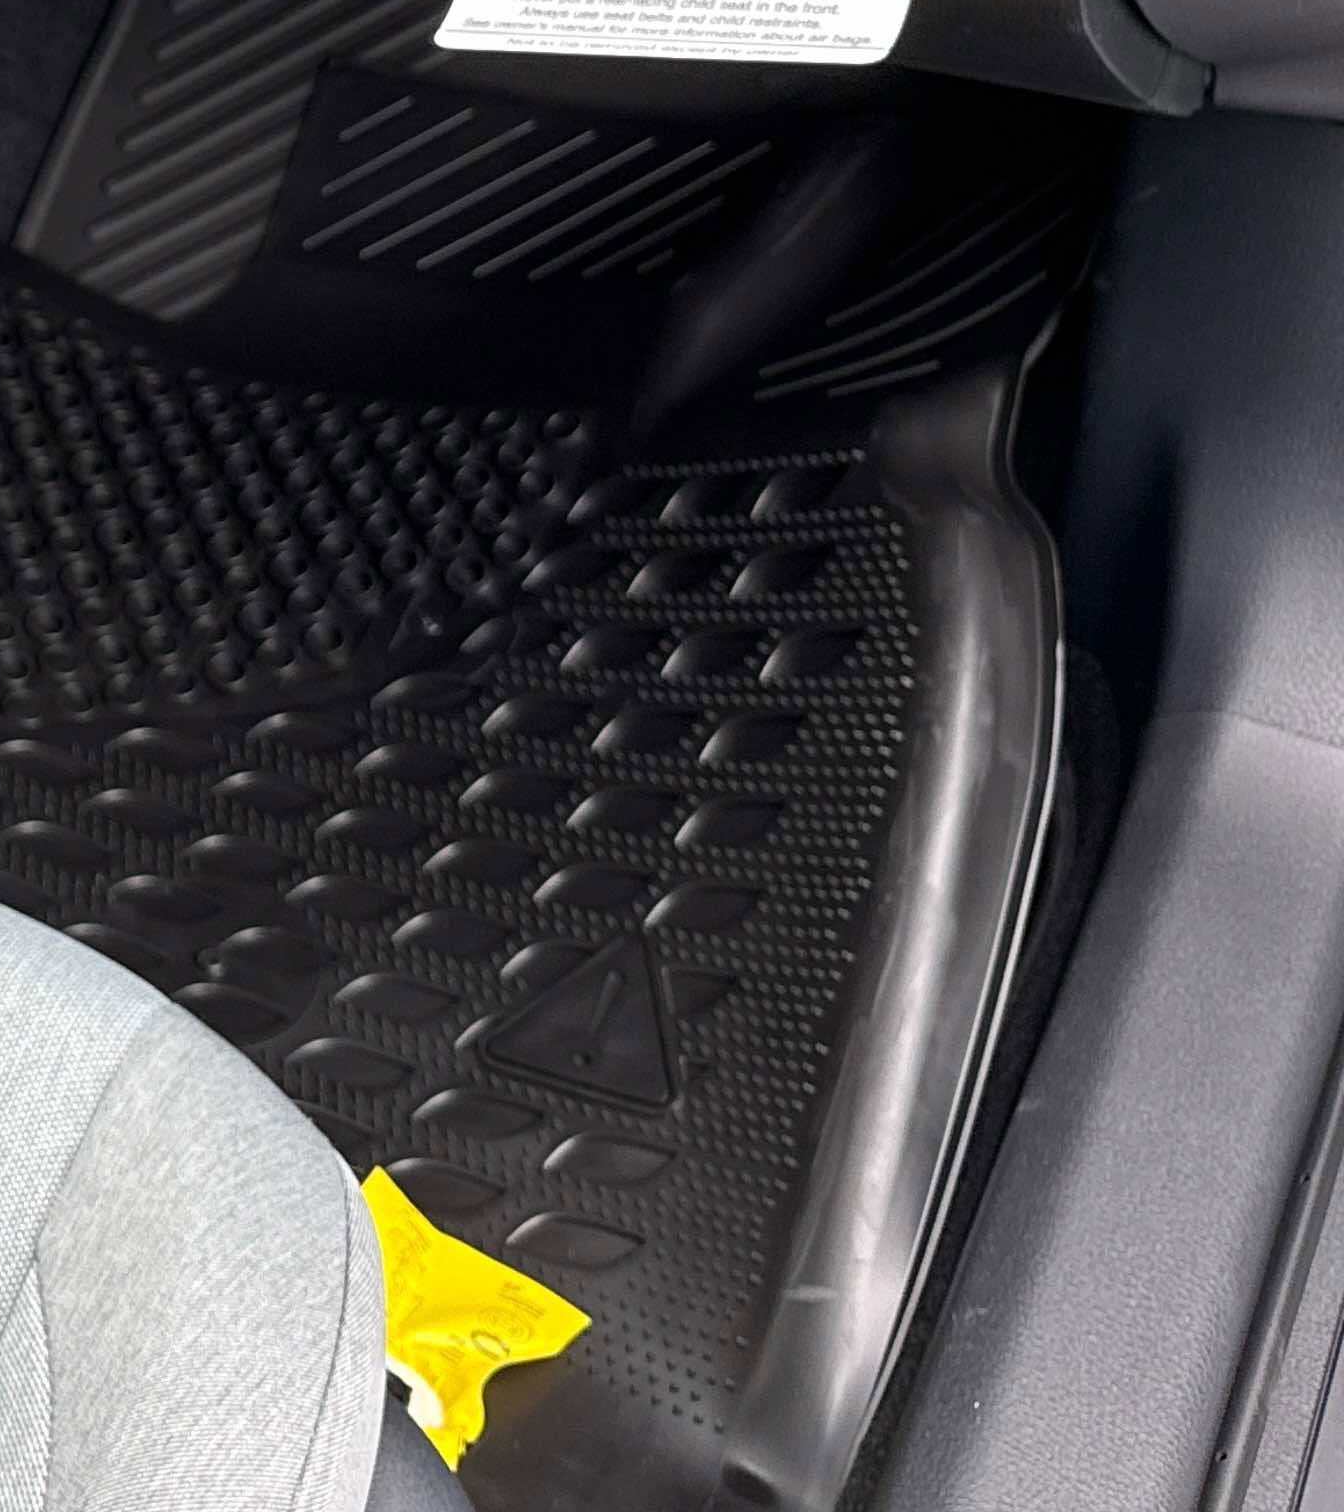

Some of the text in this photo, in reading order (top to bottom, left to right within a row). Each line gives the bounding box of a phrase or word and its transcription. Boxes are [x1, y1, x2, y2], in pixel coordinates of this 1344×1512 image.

[519, 6, 822, 30] Always use seat belts and child restraints.
[720, 0, 752, 12] seat
[757, 1, 770, 12] in
[774, 1, 798, 14] the
[802, 2, 841, 15] front.
[463, 17, 872, 47] See owner's manual for more information about air bags.
